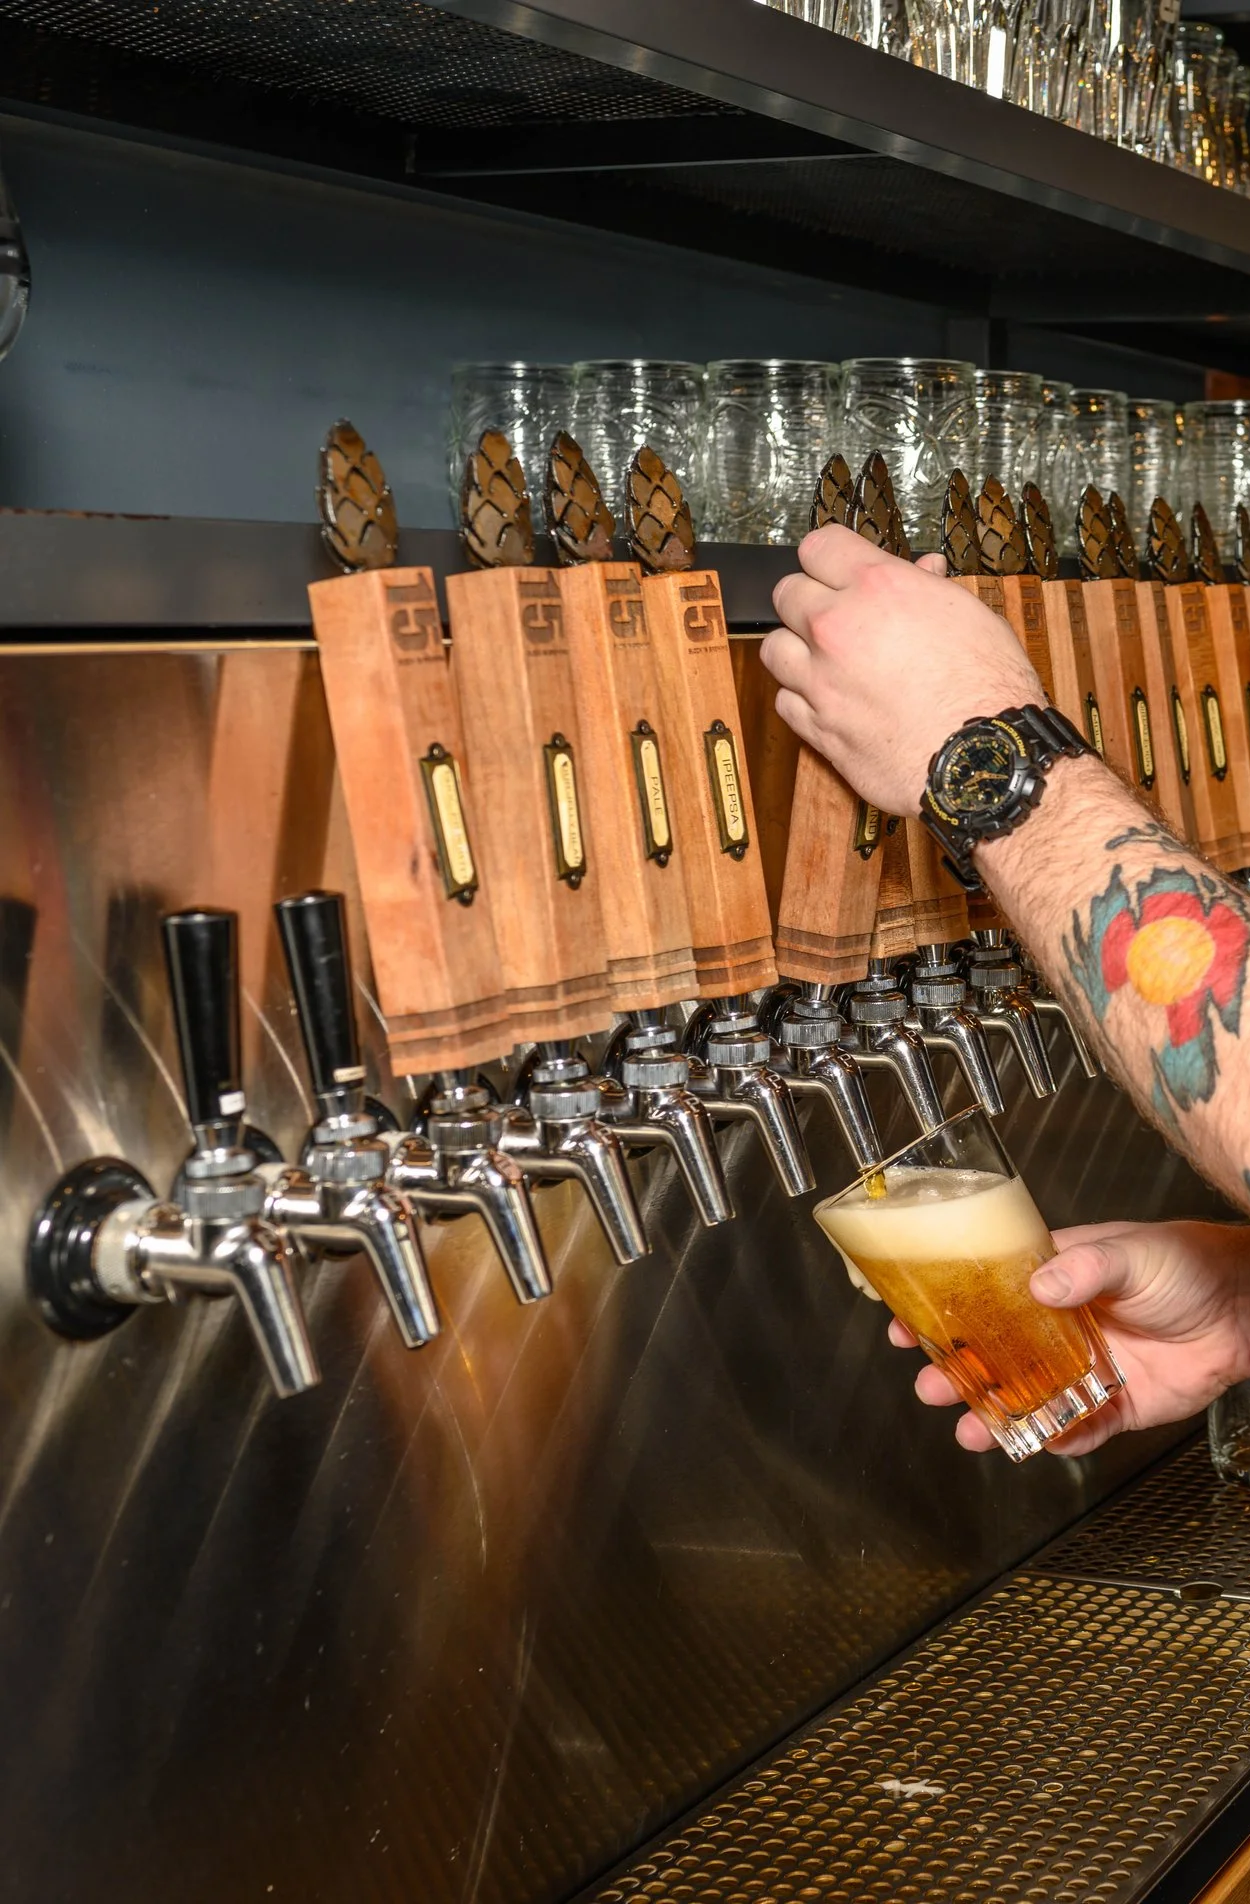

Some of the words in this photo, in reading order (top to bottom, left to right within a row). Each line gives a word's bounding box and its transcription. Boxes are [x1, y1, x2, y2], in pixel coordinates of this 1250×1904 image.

[679, 575, 726, 643] 15
[991, 719, 1027, 758] PROTECTION
[650, 776, 663, 816] PALE
[722, 758, 740, 825] IPEEPSA
